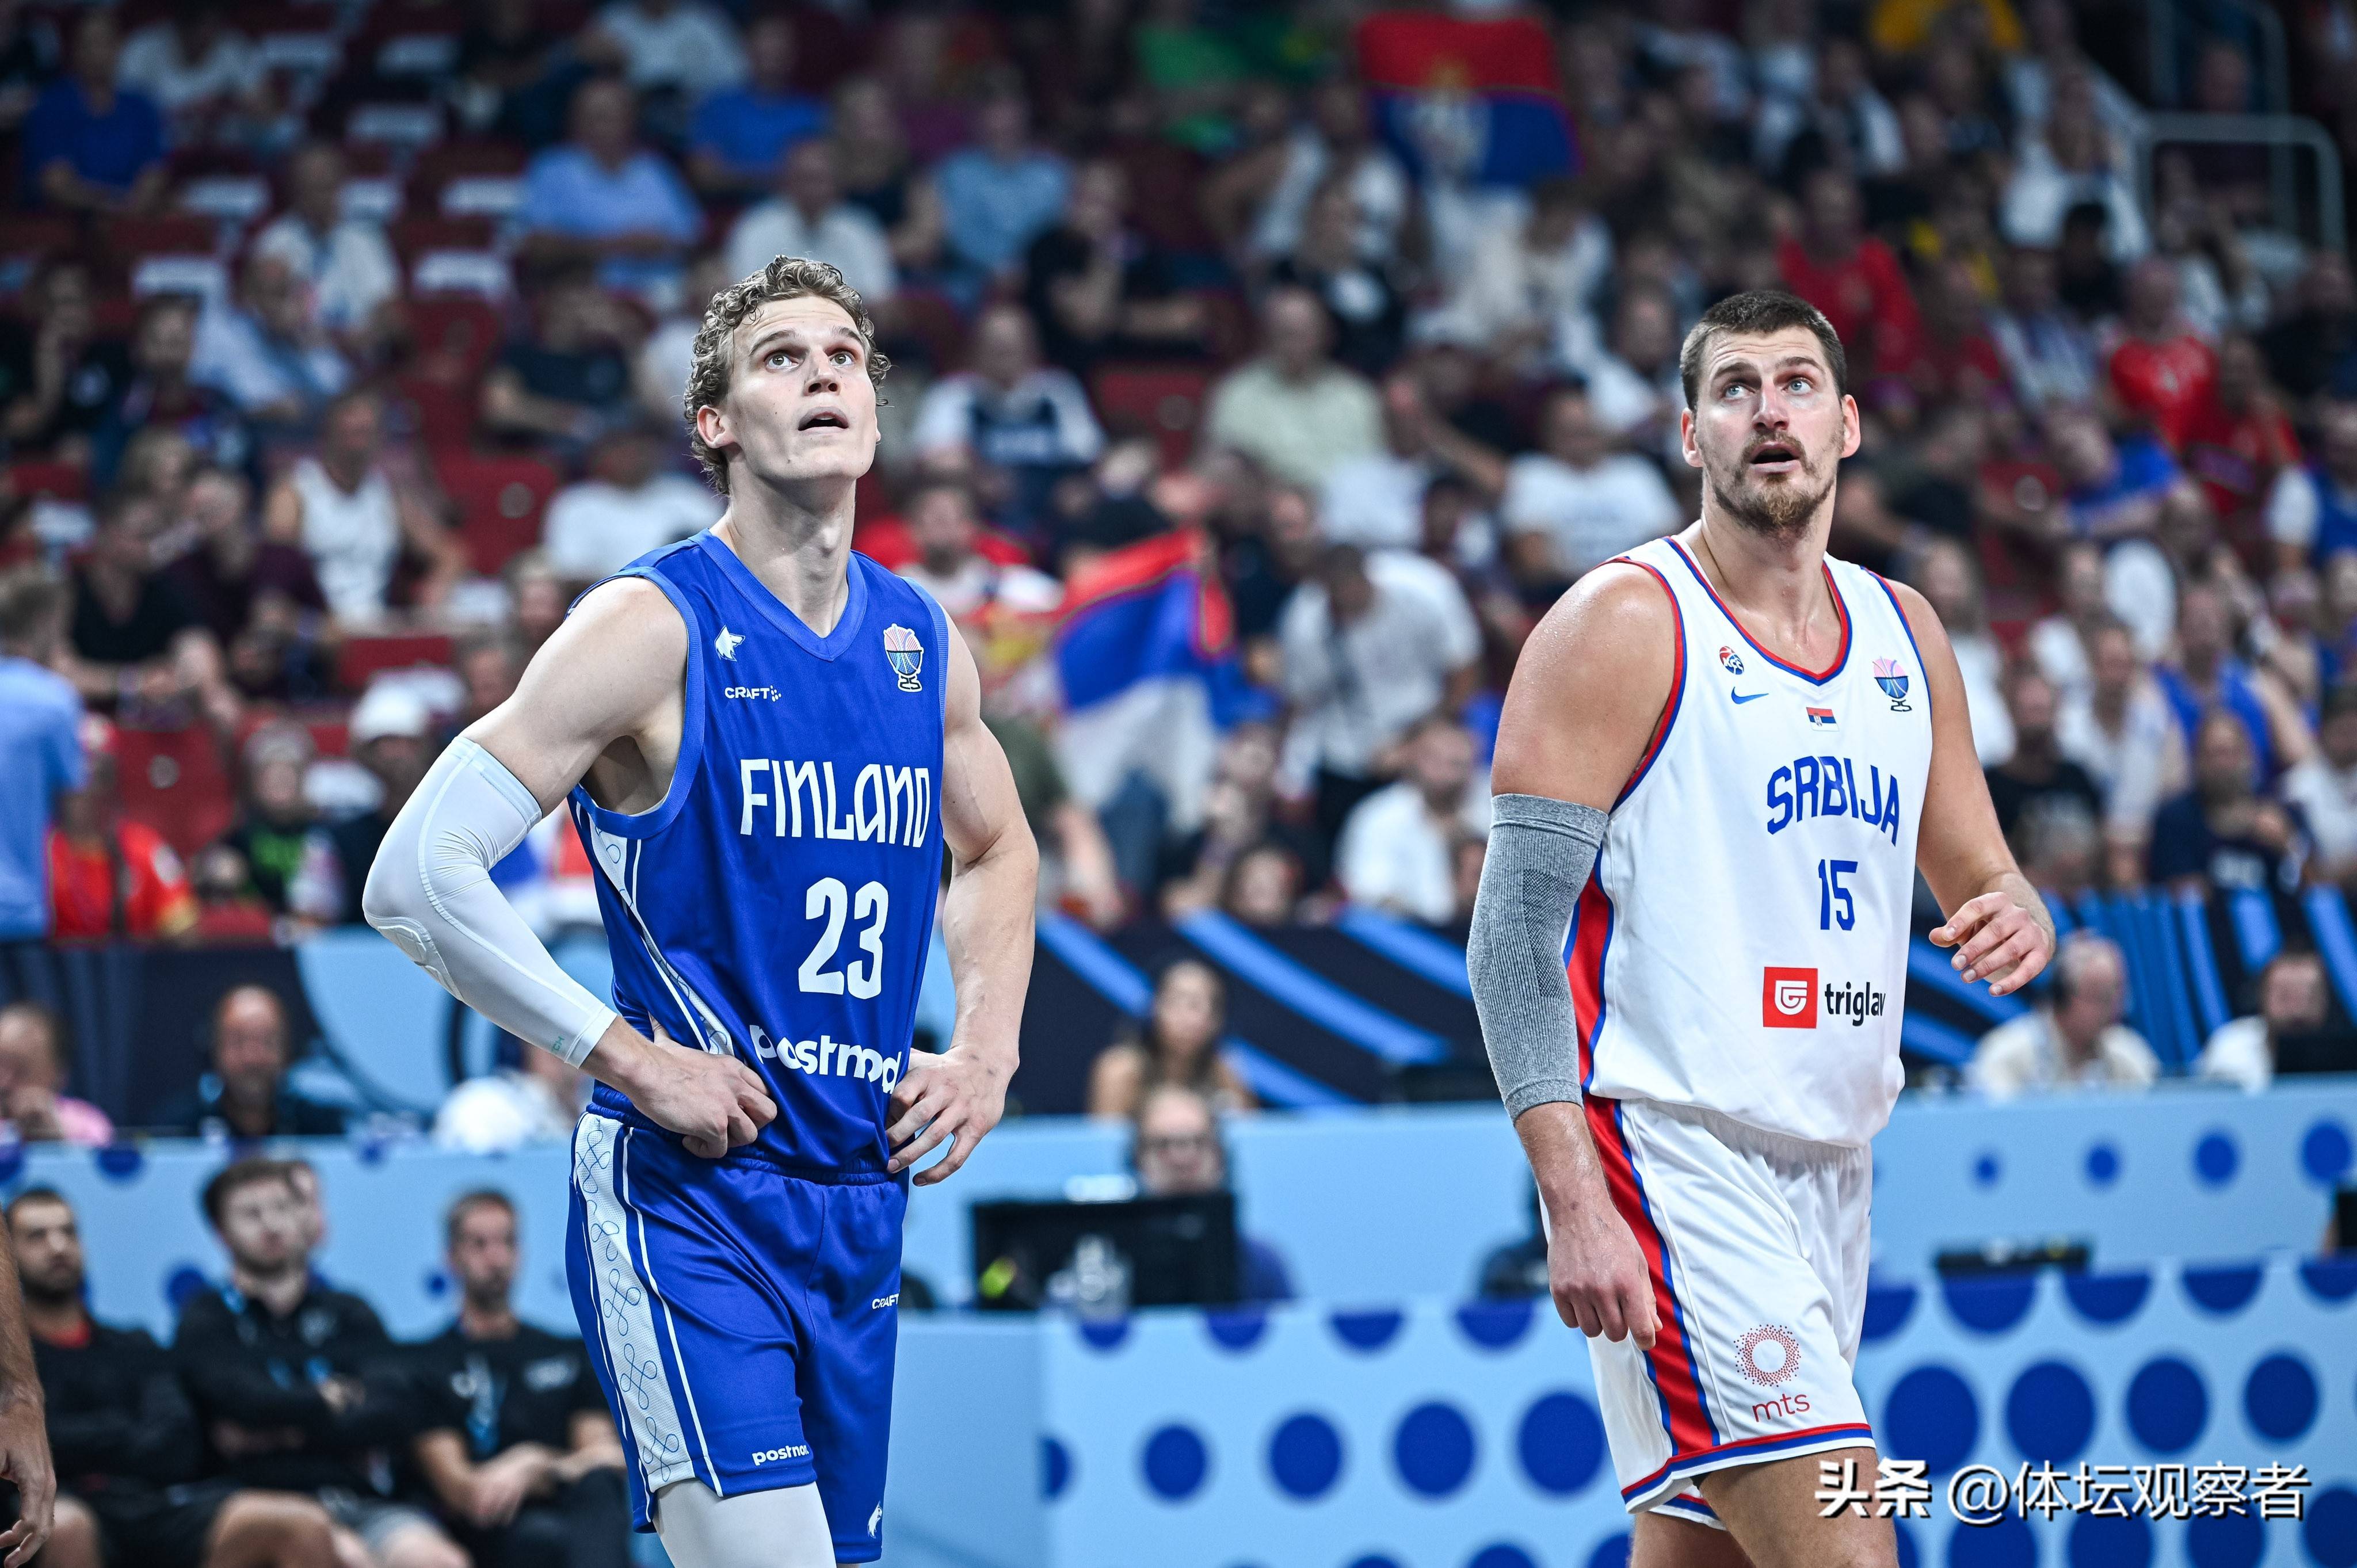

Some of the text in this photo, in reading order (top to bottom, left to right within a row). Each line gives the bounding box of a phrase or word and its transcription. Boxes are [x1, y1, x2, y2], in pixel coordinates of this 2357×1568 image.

[724, 686, 770, 700] CRAFT
[740, 758, 930, 848] FINLAND
[1767, 756, 1900, 847] SRBIJA
[1818, 859, 1859, 931] 15
[798, 877, 889, 999] 23
[1824, 981, 1886, 1027] triglav
[872, 1293, 899, 1310] CRAFT
[1752, 1393, 1810, 1422] mts
